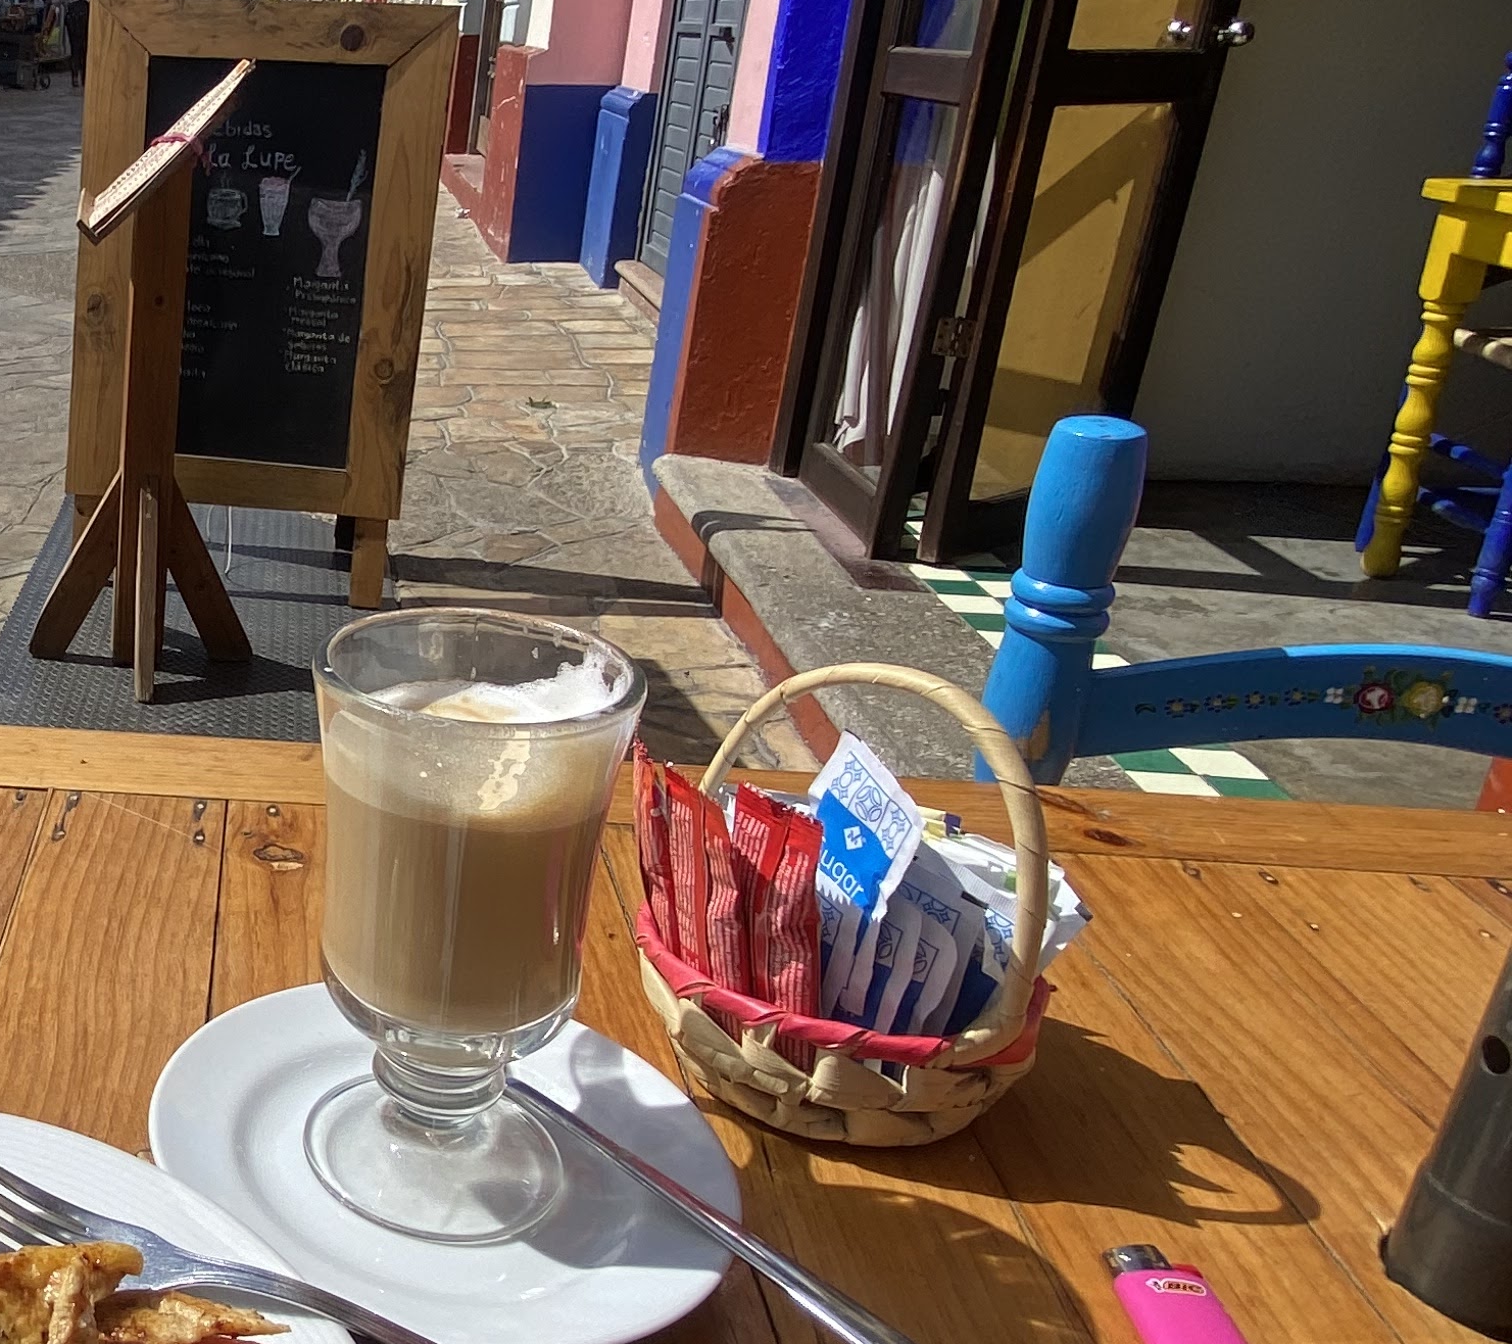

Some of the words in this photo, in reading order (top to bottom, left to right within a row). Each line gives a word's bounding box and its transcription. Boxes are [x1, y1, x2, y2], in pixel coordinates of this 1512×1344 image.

[241, 144, 297, 170] Lupe
[819, 836, 865, 898] ugar
[1166, 1281, 1204, 1294] BIC
